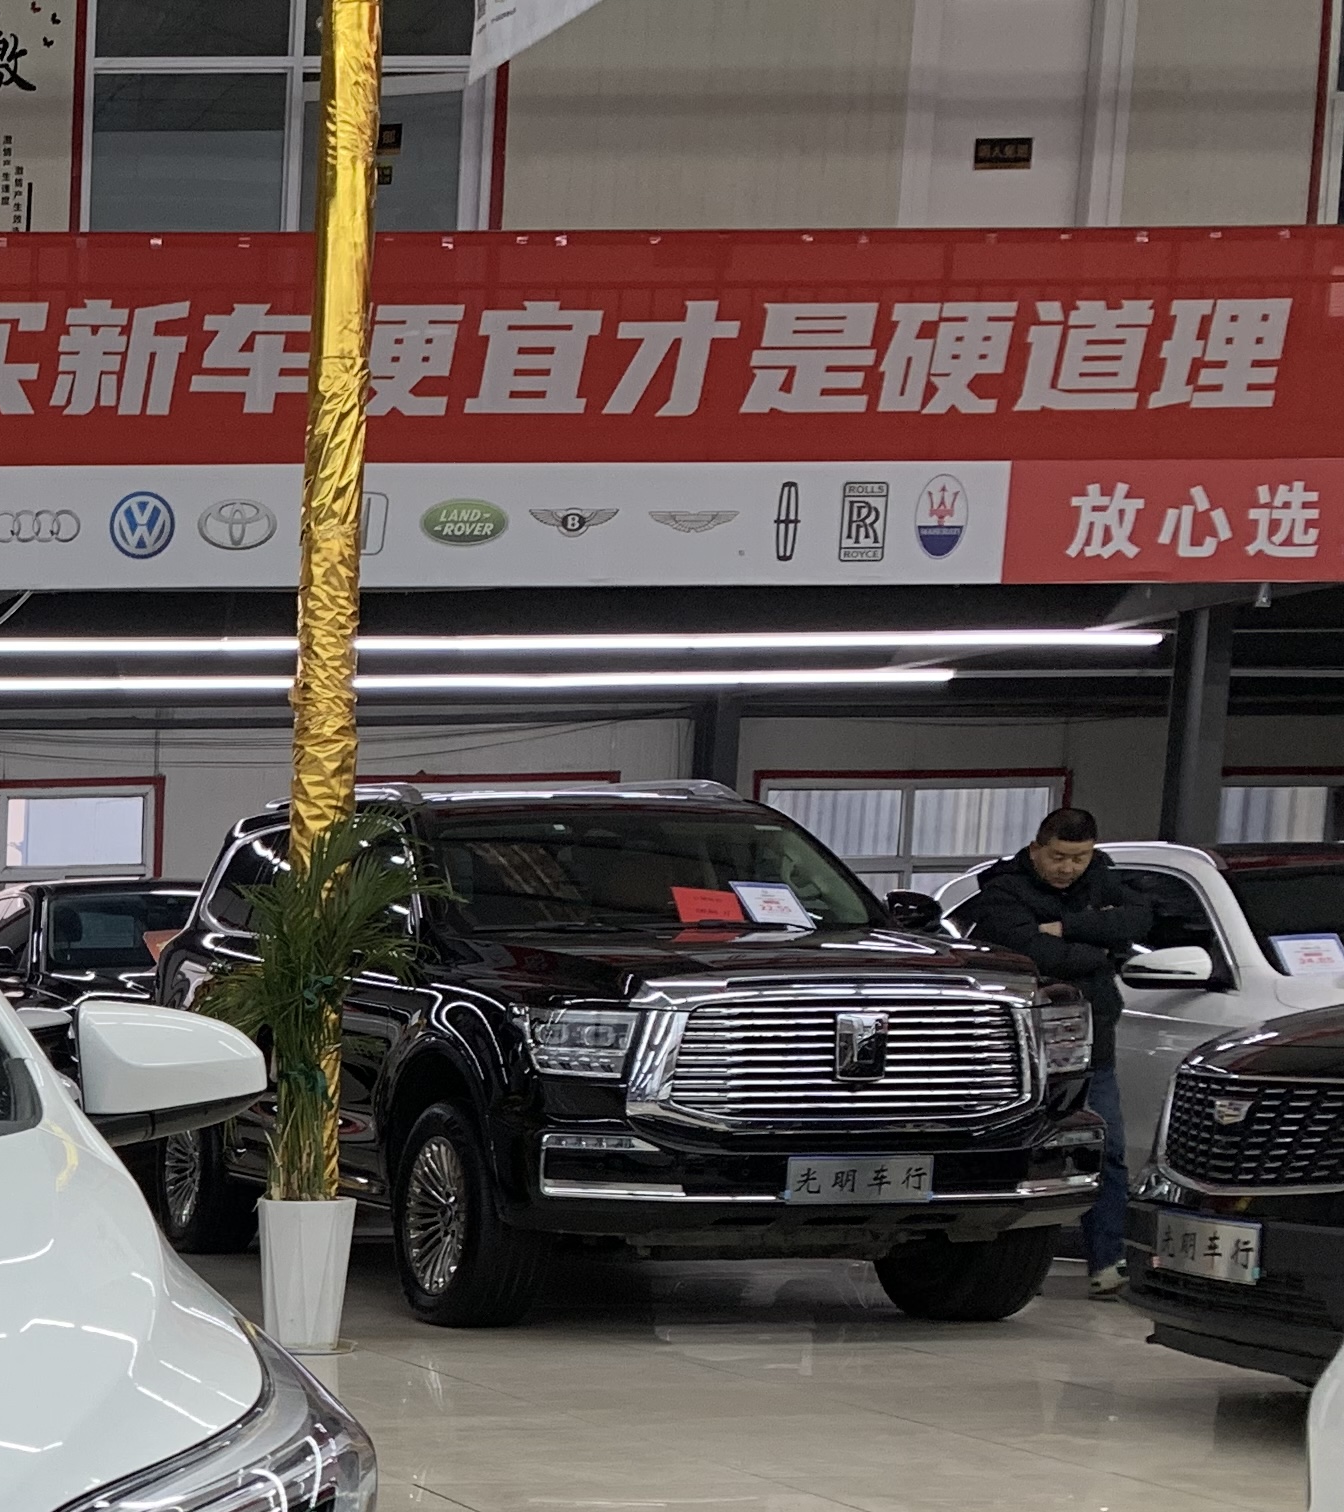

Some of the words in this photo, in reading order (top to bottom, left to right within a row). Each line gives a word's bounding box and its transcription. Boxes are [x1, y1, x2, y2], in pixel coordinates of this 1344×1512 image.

[847, 484, 885, 494] ROLLS
[1066, 481, 1321, 560] 放心选
[843, 549, 880, 559] ROYCE
[793, 1164, 928, 1196] 光明车行
